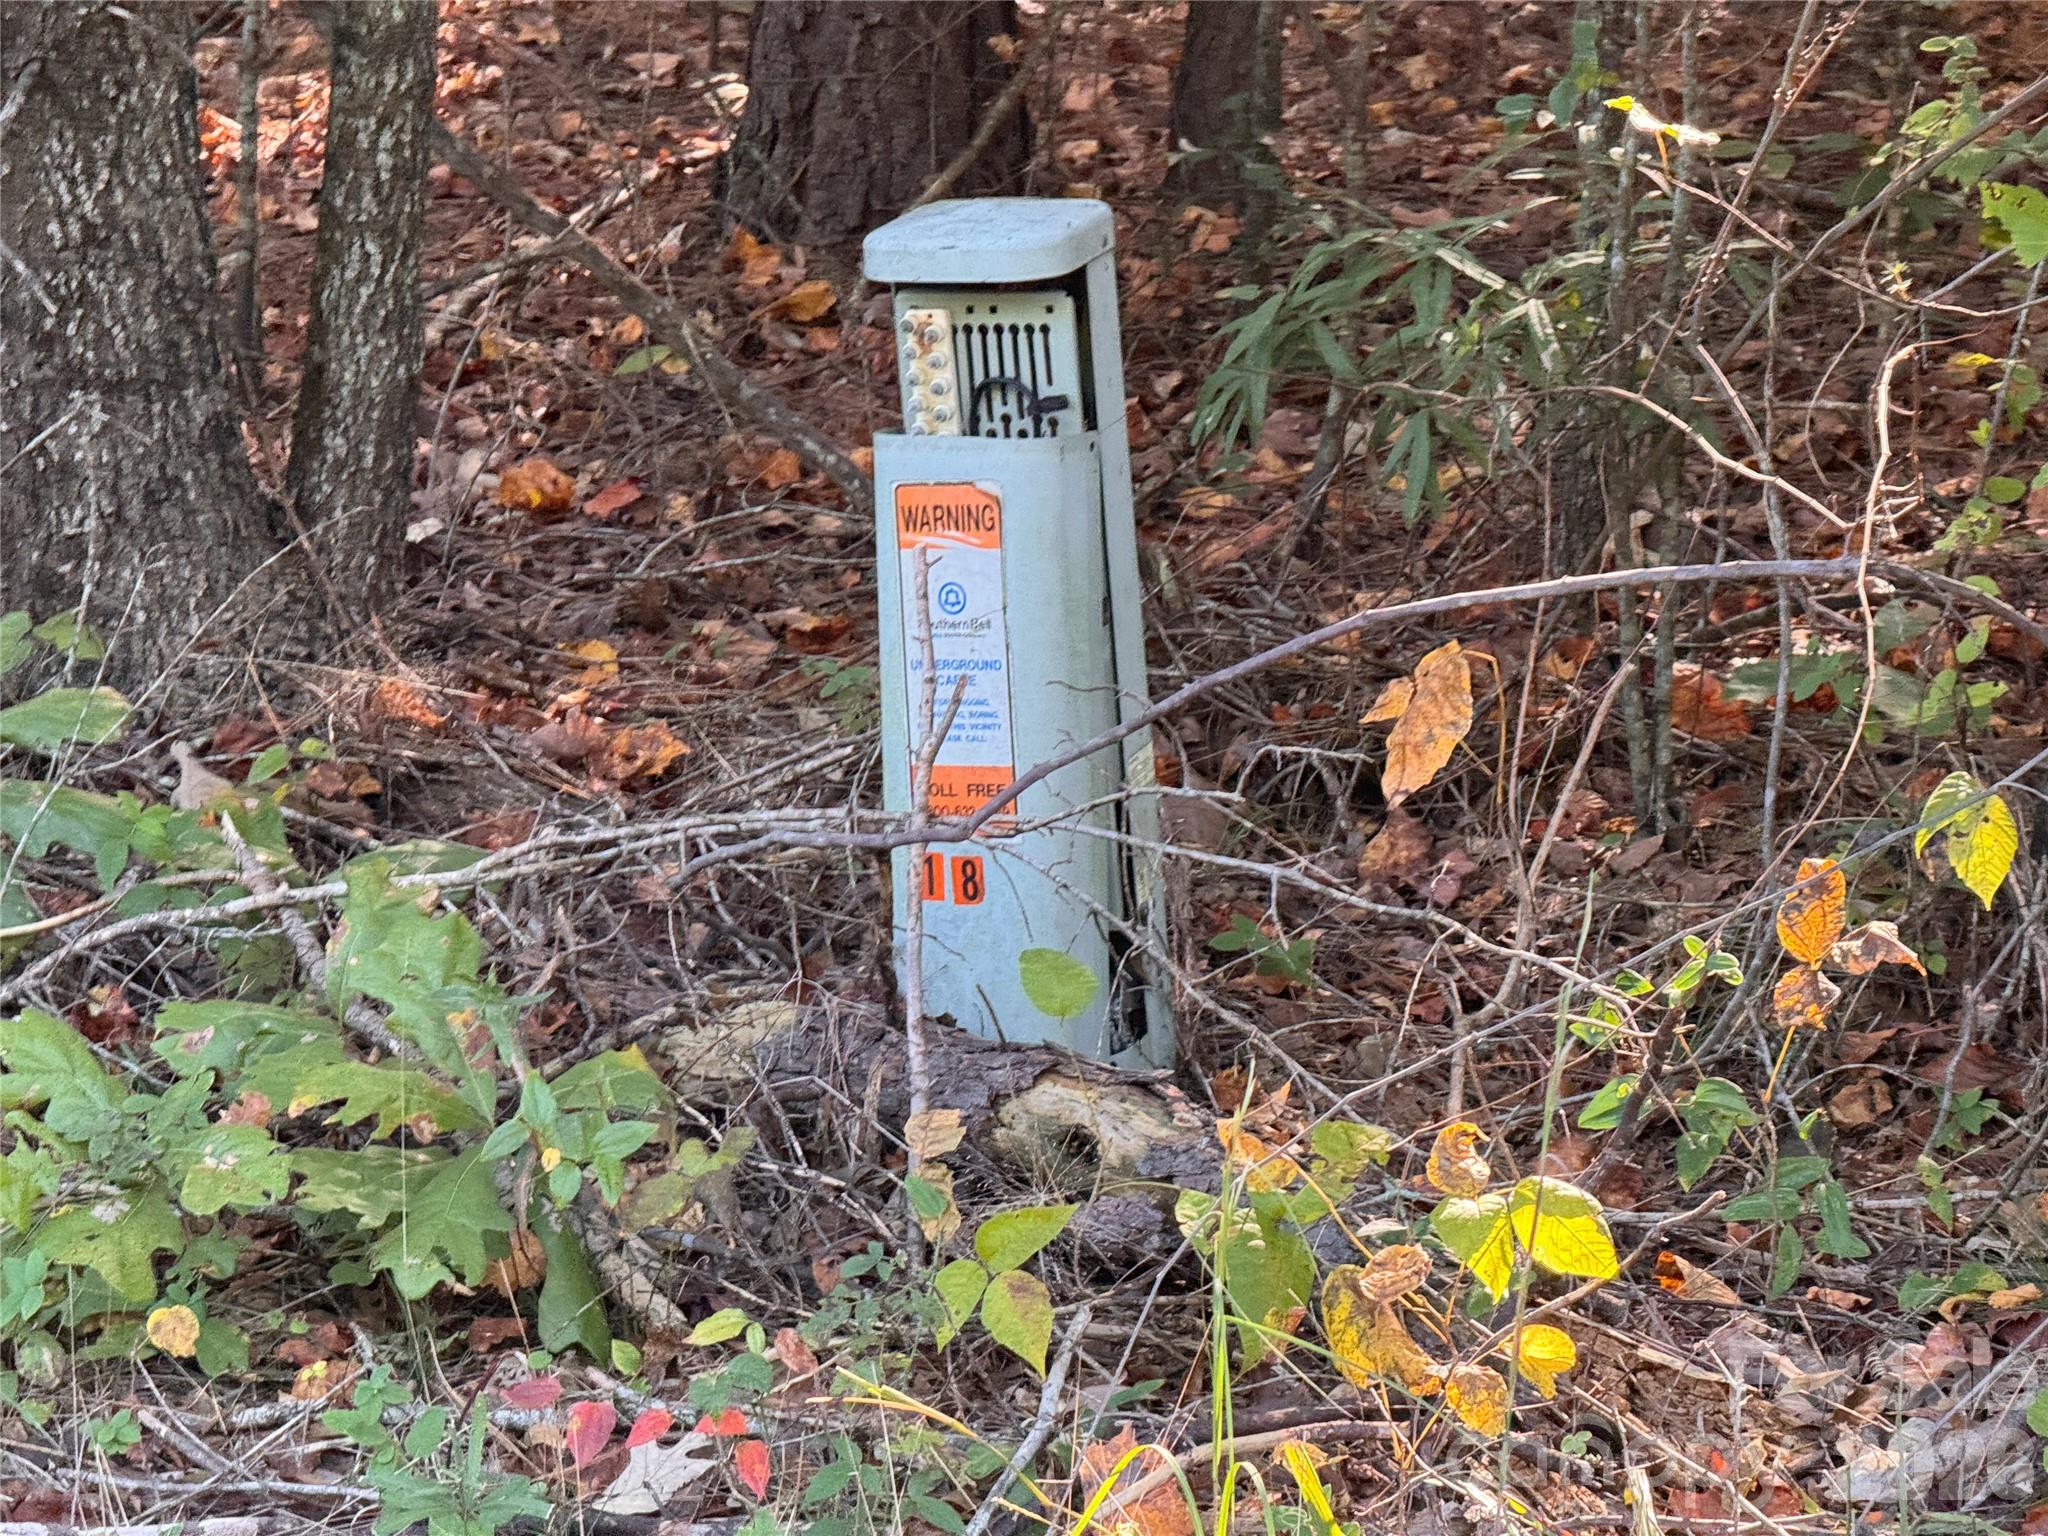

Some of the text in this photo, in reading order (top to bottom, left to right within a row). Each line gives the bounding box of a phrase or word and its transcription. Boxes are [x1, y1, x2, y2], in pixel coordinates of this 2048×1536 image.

[900, 504, 996, 532] WARNING
[910, 658, 1002, 671] UNERGROUND
[936, 674, 977, 686] CAE
[928, 782, 1006, 797] OLL FREE
